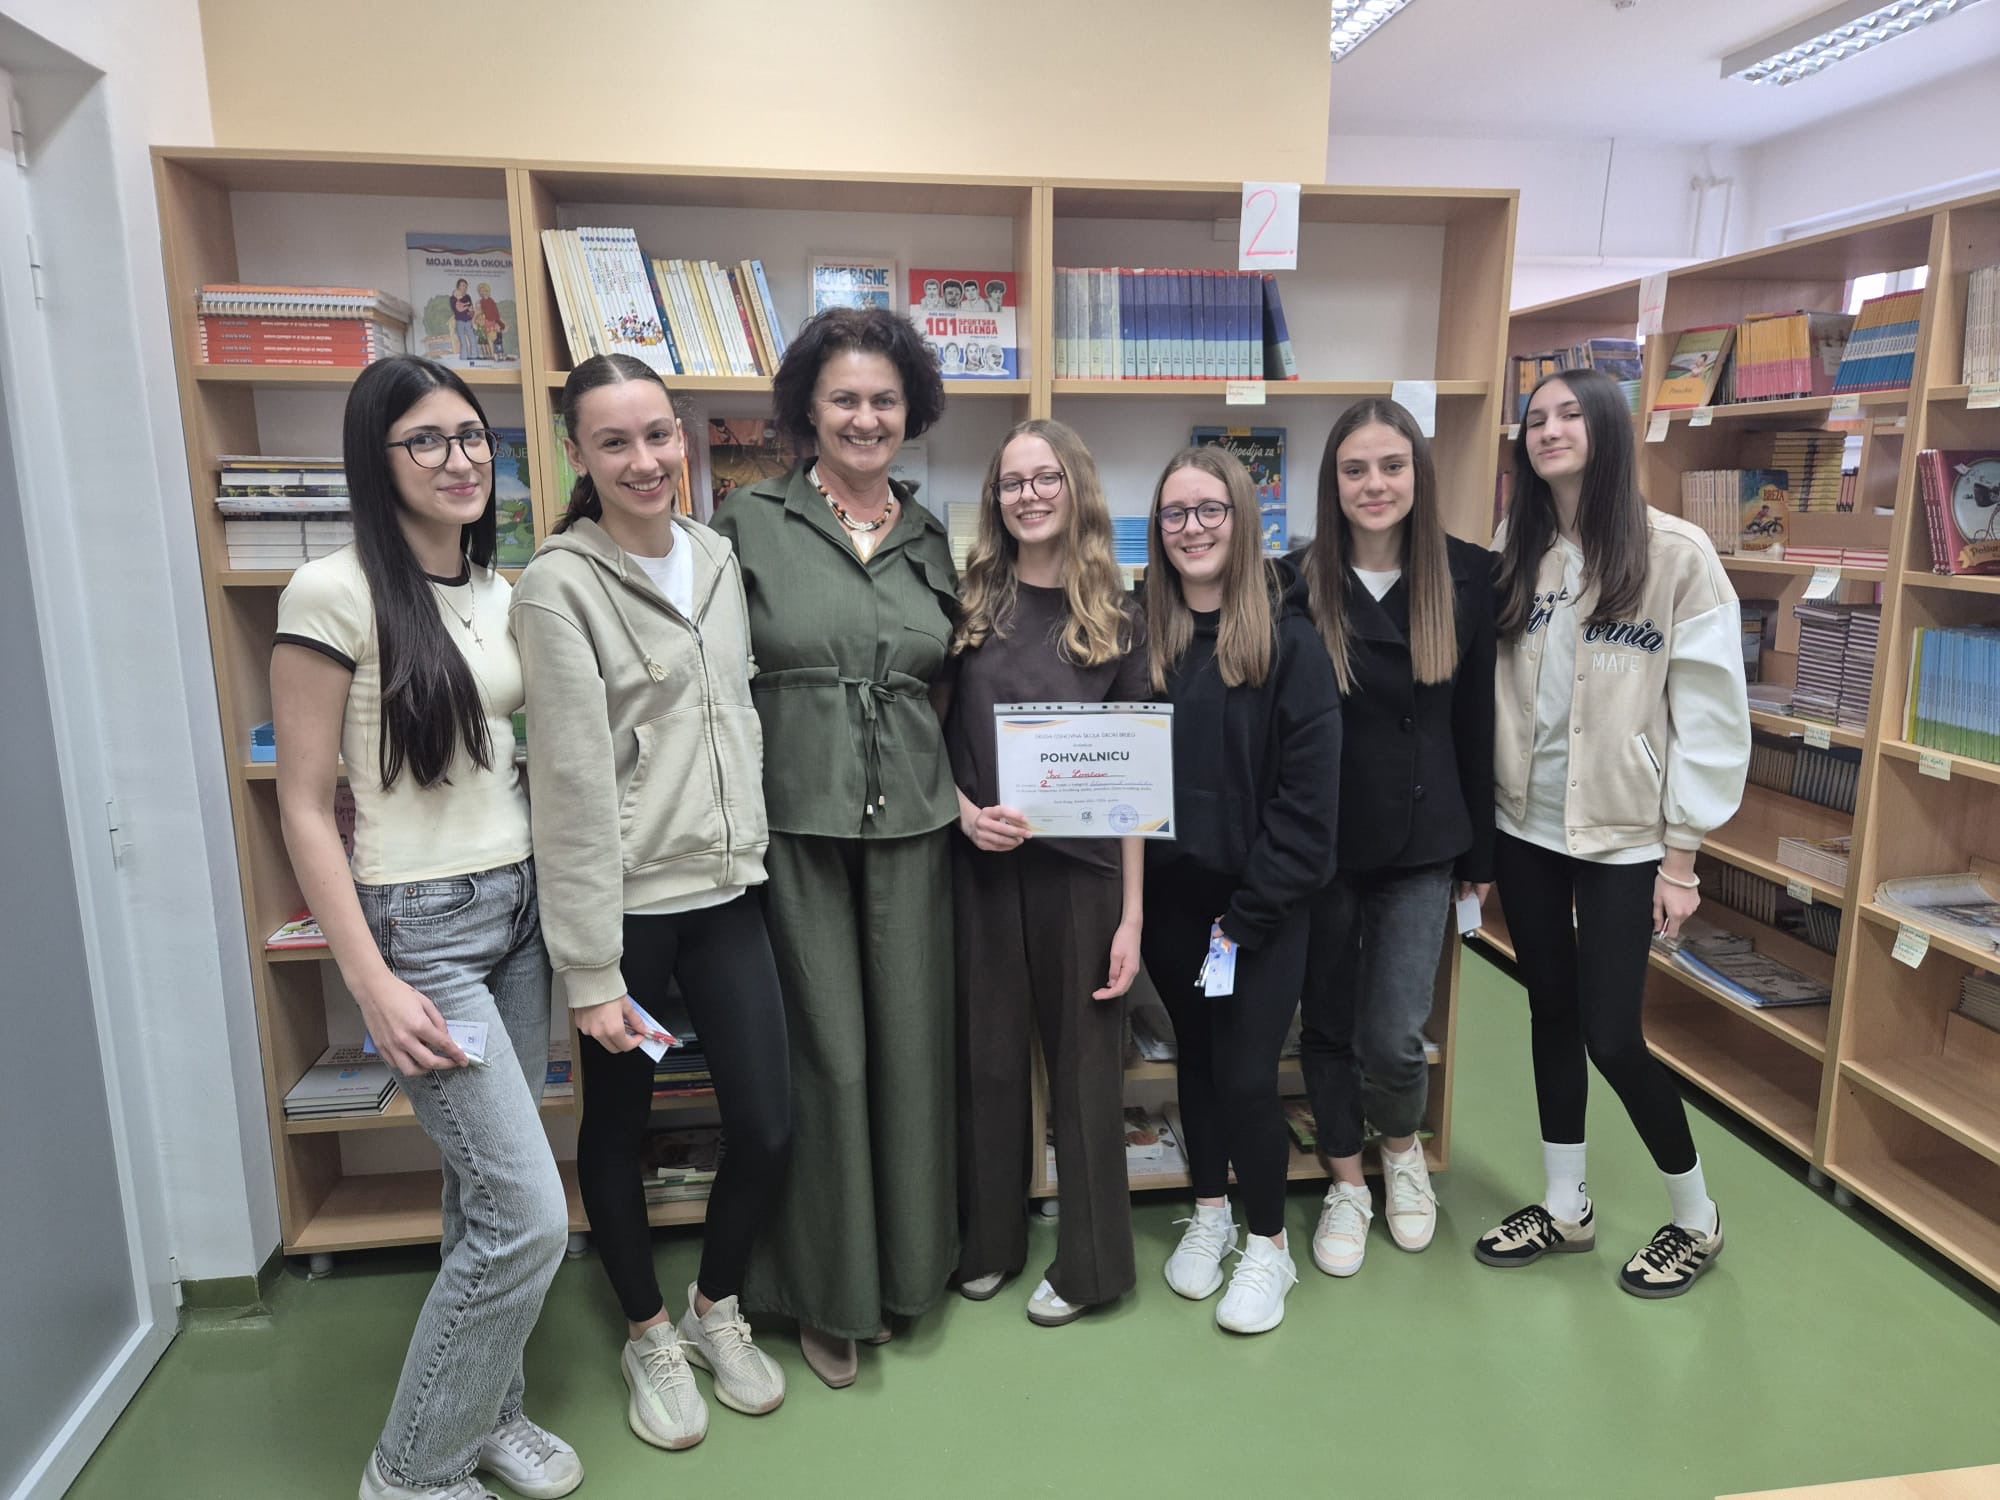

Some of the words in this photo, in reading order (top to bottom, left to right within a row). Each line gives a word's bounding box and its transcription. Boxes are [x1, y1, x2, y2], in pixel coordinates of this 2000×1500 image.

[1246, 189, 1294, 256] 2.
[425, 257, 452, 267] MOJA
[454, 257, 479, 268] BLIŽA
[849, 267, 889, 287] BASNE
[925, 317, 957, 336] 101
[959, 318, 997, 326] SPORTSKA
[959, 325, 999, 335] LEGENDA
[1264, 448, 1275, 457] za
[1592, 652, 1641, 673] MATE
[1040, 751, 1130, 763] POHVALNICU
